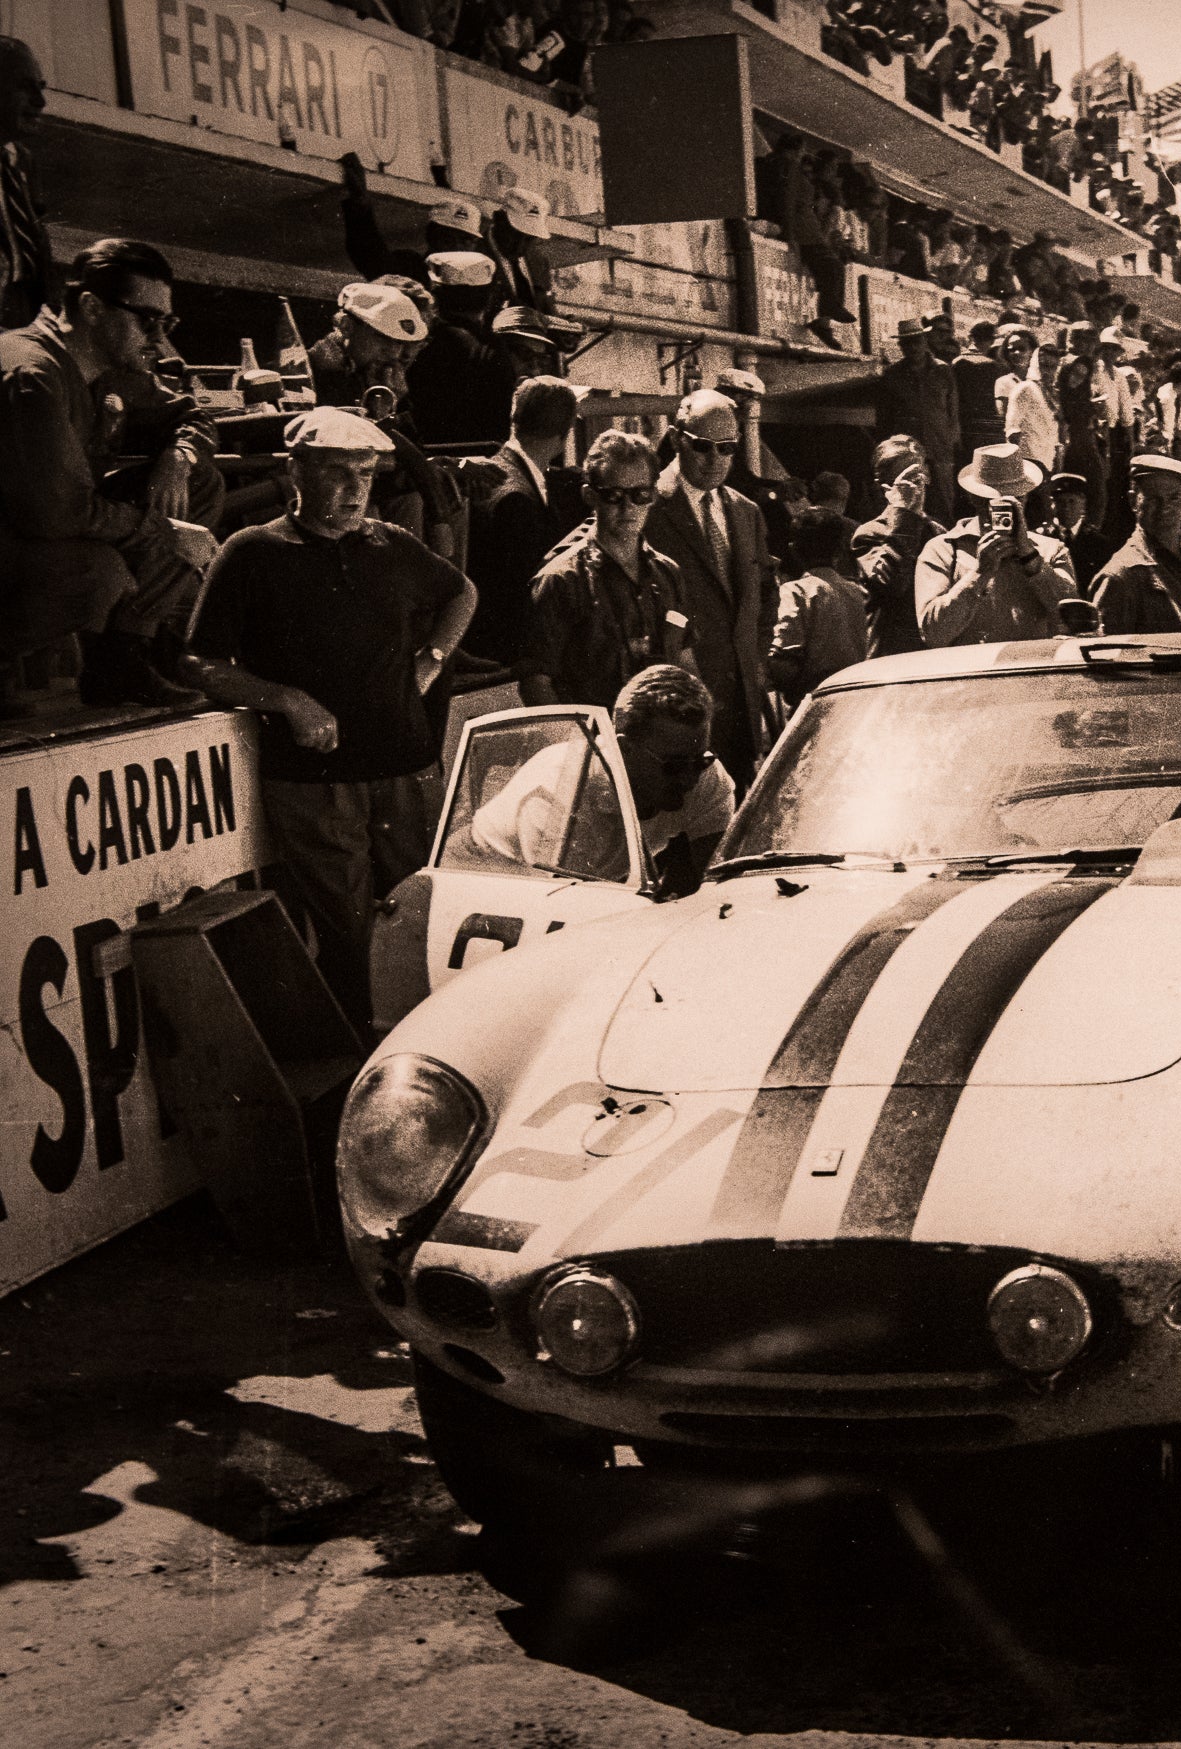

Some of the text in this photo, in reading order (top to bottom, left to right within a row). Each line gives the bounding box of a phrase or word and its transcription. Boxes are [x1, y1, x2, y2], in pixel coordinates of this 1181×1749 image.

[156, 0, 342, 138] FERRARI
[14, 742, 236, 895] A CARDAN
